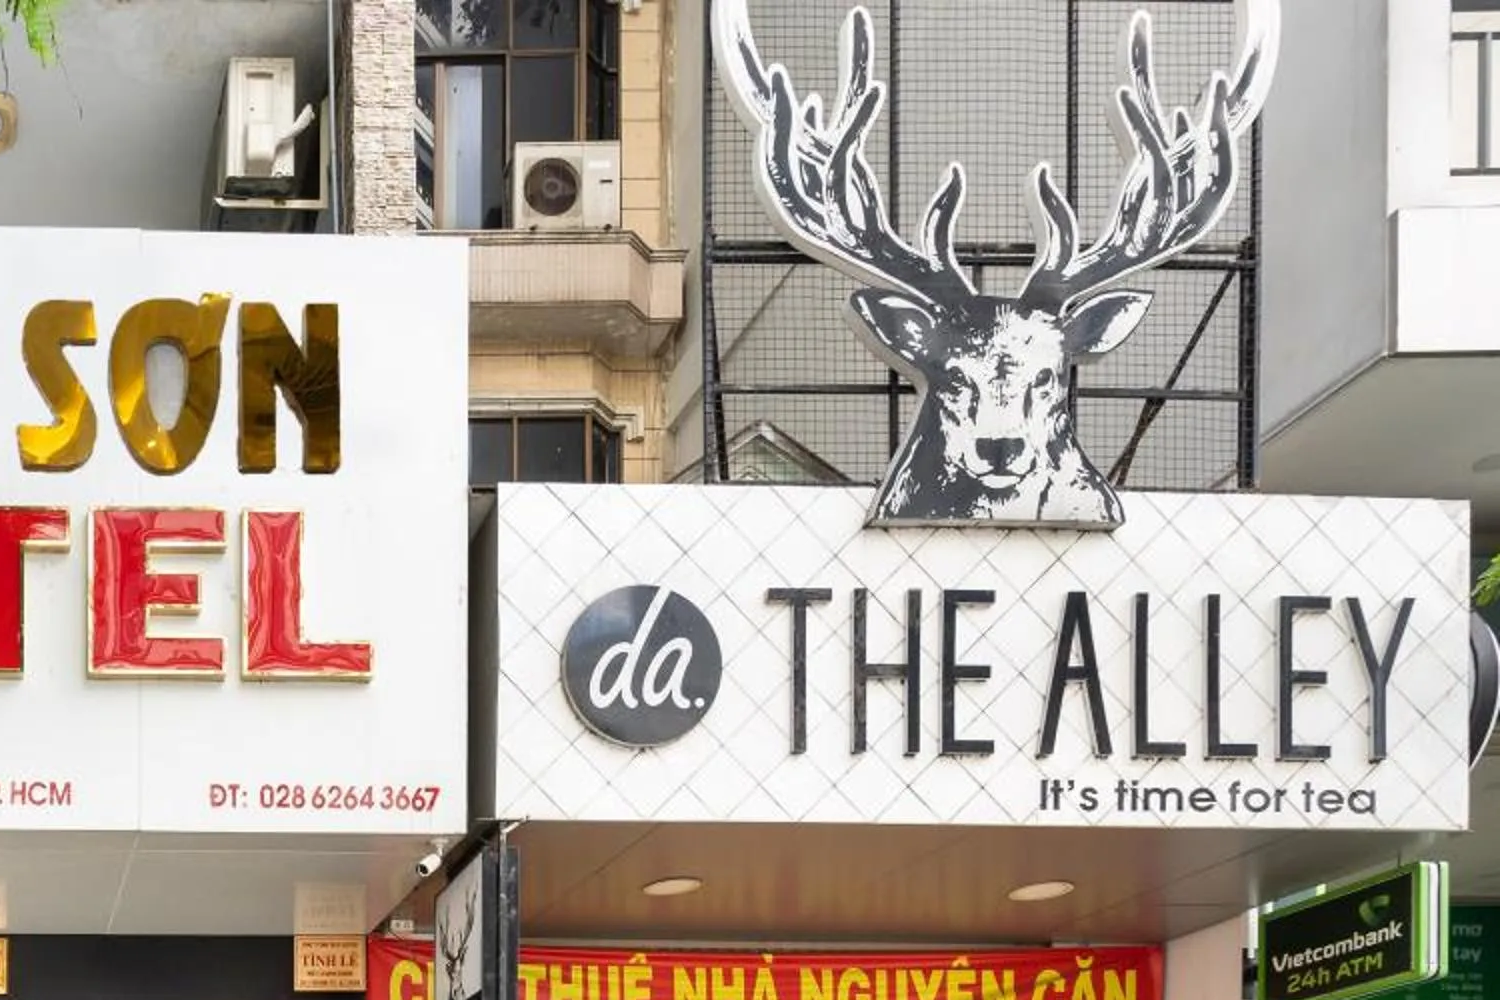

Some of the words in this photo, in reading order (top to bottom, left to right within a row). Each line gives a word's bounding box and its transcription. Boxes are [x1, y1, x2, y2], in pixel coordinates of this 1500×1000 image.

[16, 291, 342, 476] SƠN
[765, 587, 995, 758] THE
[1034, 591, 1416, 764] ALLEY
[208, 784, 247, 808] ĐT:
[1039, 778, 1098, 813] It's
[1113, 778, 1218, 814] time
[1229, 780, 1290, 814] for
[1302, 782, 1377, 815] tea
[1271, 920, 1404, 973] Vietcombank
[1287, 968, 1330, 993] 24h
[1335, 951, 1384, 981] ATM
